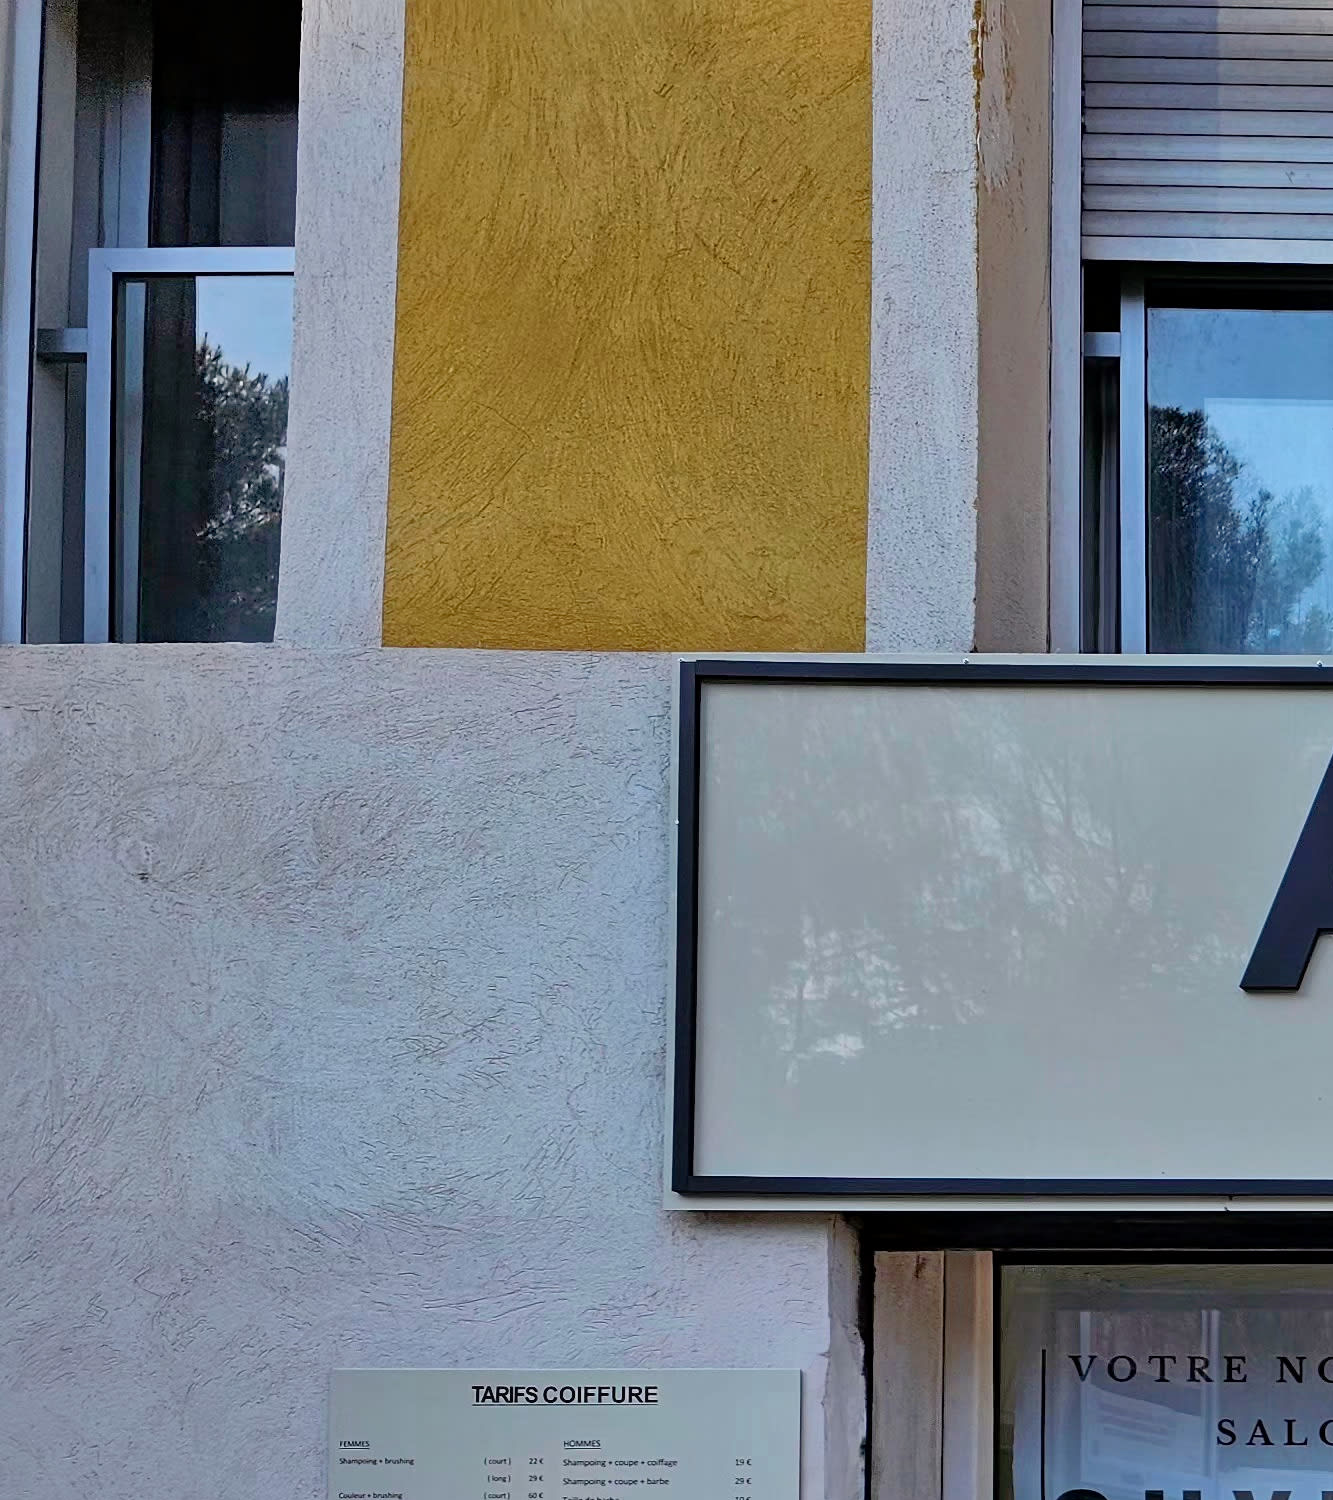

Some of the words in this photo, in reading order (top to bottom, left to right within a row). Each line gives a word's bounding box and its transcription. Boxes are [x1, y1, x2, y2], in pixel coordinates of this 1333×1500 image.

[1067, 1355, 1248, 1383] VOTRE
[471, 1385, 539, 1403] TARIFS
[542, 1385, 659, 1403] COIFFURE
[563, 1439, 601, 1448] HOMMES
[339, 1457, 378, 1466] Shampoing
[384, 1457, 415, 1466] brushing
[528, 1457, 538, 1465] 22
[562, 1458, 607, 1468] Shampoing
[614, 1460, 639, 1468] coupe
[646, 1458, 678, 1468] coiffage
[735, 1458, 745, 1467] 19
[562, 1477, 607, 1487] Shampoing
[613, 1479, 639, 1487] coupe
[646, 1477, 670, 1485] barbe
[734, 1477, 745, 1485] 29
[338, 1491, 367, 1500] Couleur
[372, 1491, 403, 1500] brushing
